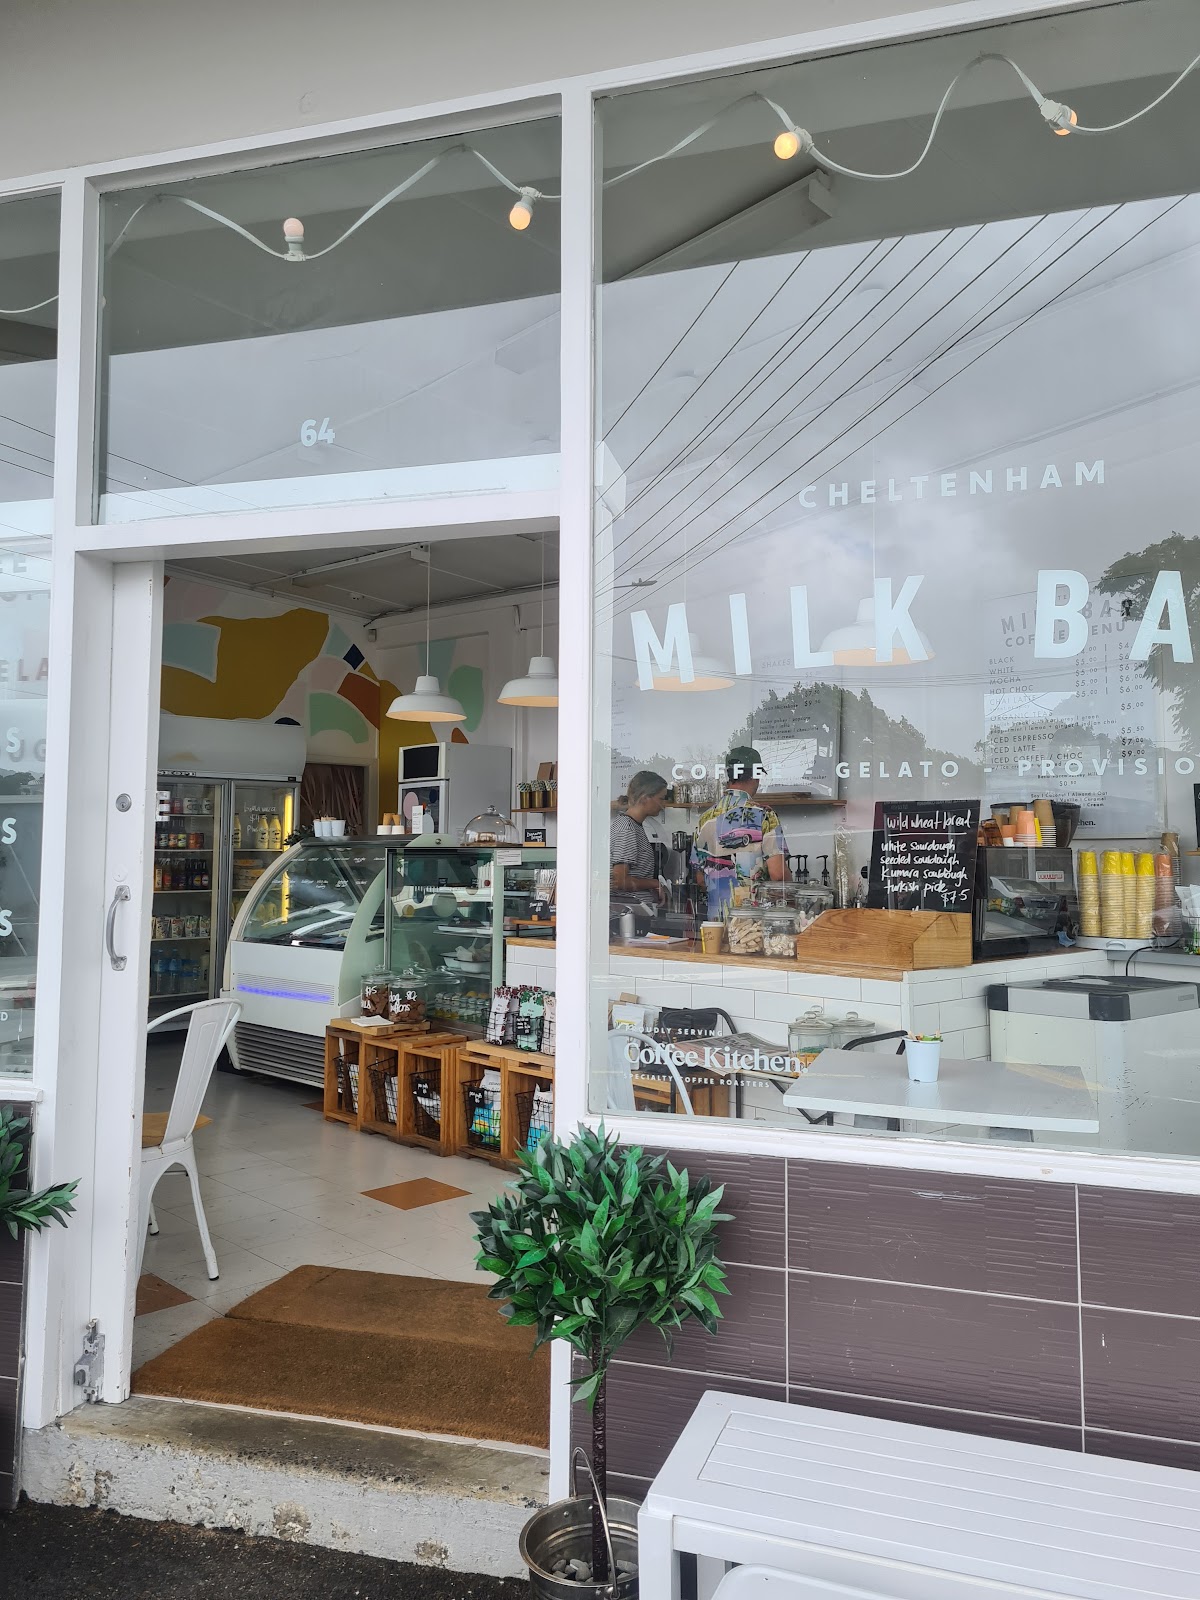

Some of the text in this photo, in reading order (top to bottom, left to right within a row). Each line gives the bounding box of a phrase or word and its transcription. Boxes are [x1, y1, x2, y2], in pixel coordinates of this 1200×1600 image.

[301, 418, 335, 446] 64
[799, 460, 1105, 508] CHELTENHAM
[630, 569, 1194, 691] MILK BA
[989, 656, 1015, 665] BLACK
[989, 666, 1014, 675] WHITE
[990, 676, 1021, 685] MOCHA
[1076, 673, 1143, 688] $5.00 $6.00
[1009, 684, 1034, 693] CHOC
[1076, 684, 1143, 698] $5.00 $6.00
[1121, 701, 1144, 711] $5.00
[1121, 725, 1145, 735] $5.50
[1012, 733, 1055, 743] ESPRESSO
[1121, 737, 1144, 746] $7.00
[1013, 744, 1036, 753] LATTE
[1121, 748, 1145, 758] $9.00
[991, 756, 1010, 764] ICED
[1056, 751, 1083, 760] CHOC
[671, 763, 782, 780] COFFEE
[836, 761, 960, 779] GELATO
[1018, 757, 1195, 777] PROVISIO
[887, 809, 971, 831] wild wheat bread
[883, 880, 920, 895] turkish
[677, 1027, 723, 1036] SERVING
[624, 1042, 699, 1068] Coffee
[624, 1073, 673, 1082] SPECIALTY
[719, 1079, 770, 1088] ROASTERS
